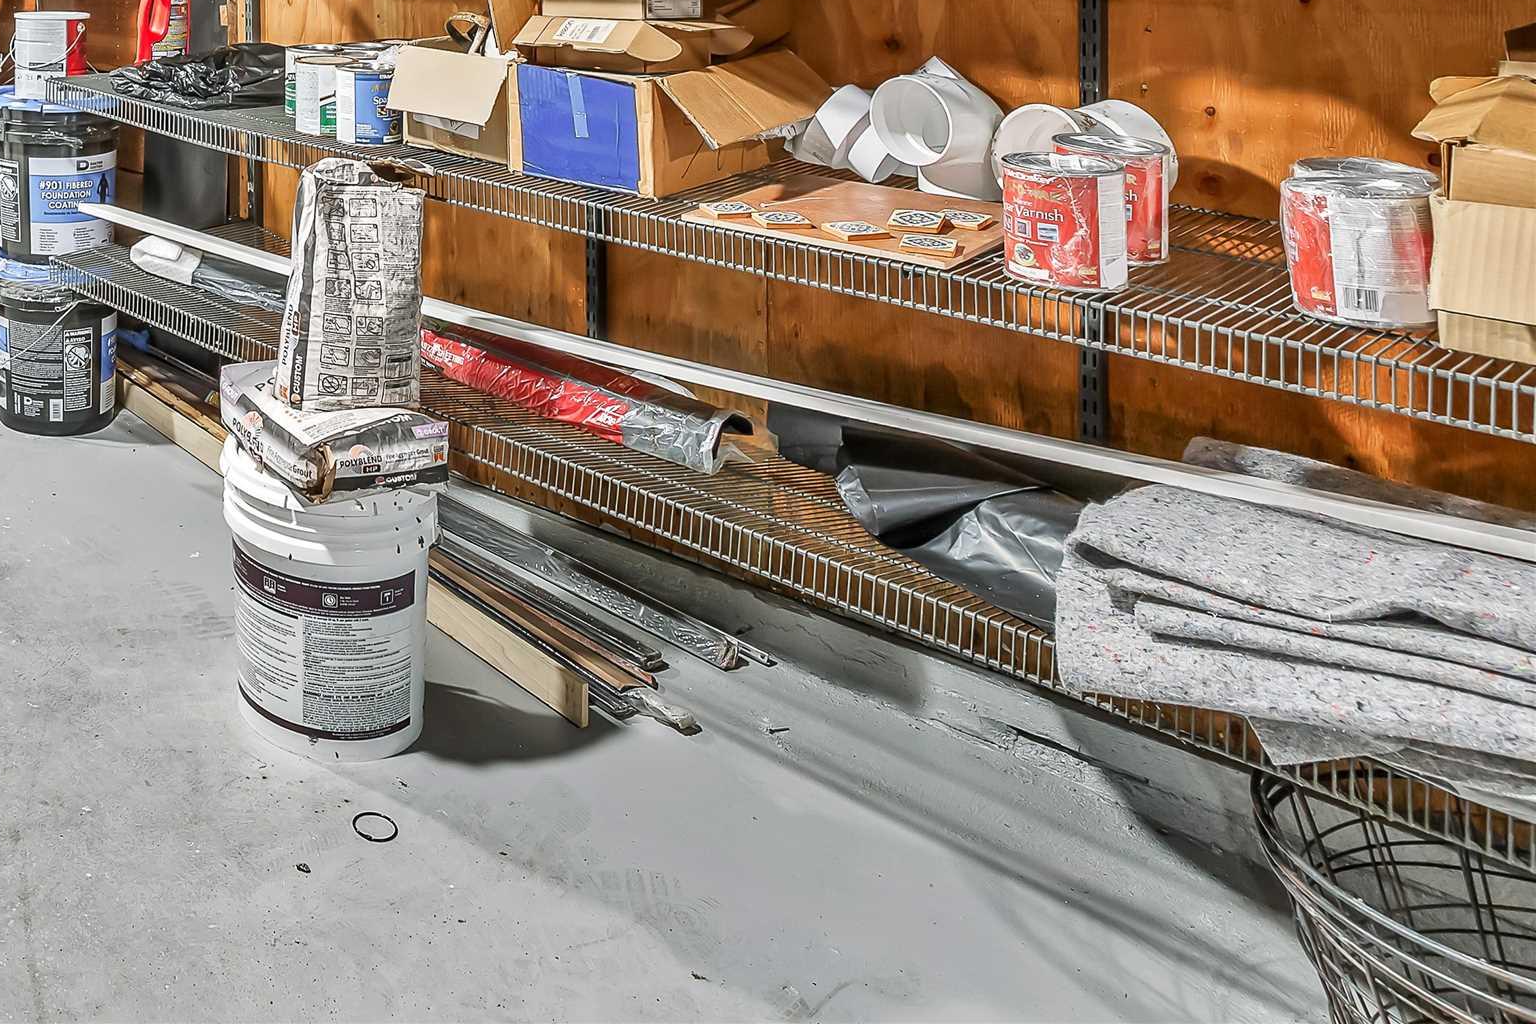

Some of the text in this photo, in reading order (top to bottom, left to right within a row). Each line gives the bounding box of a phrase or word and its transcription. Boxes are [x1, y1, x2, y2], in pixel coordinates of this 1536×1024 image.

[40, 180, 93, 190] #901 FIBERED
[41, 191, 92, 200] FOUNDATION
[48, 201, 81, 209] COATIN
[1015, 204, 1064, 222] Varnish
[282, 304, 293, 366] POLYBLEND
[293, 355, 303, 393] CUSTOM
[340, 456, 383, 469] POLYBLEND
[293, 464, 313, 480] Grout
[386, 473, 418, 483] CUSTOM
